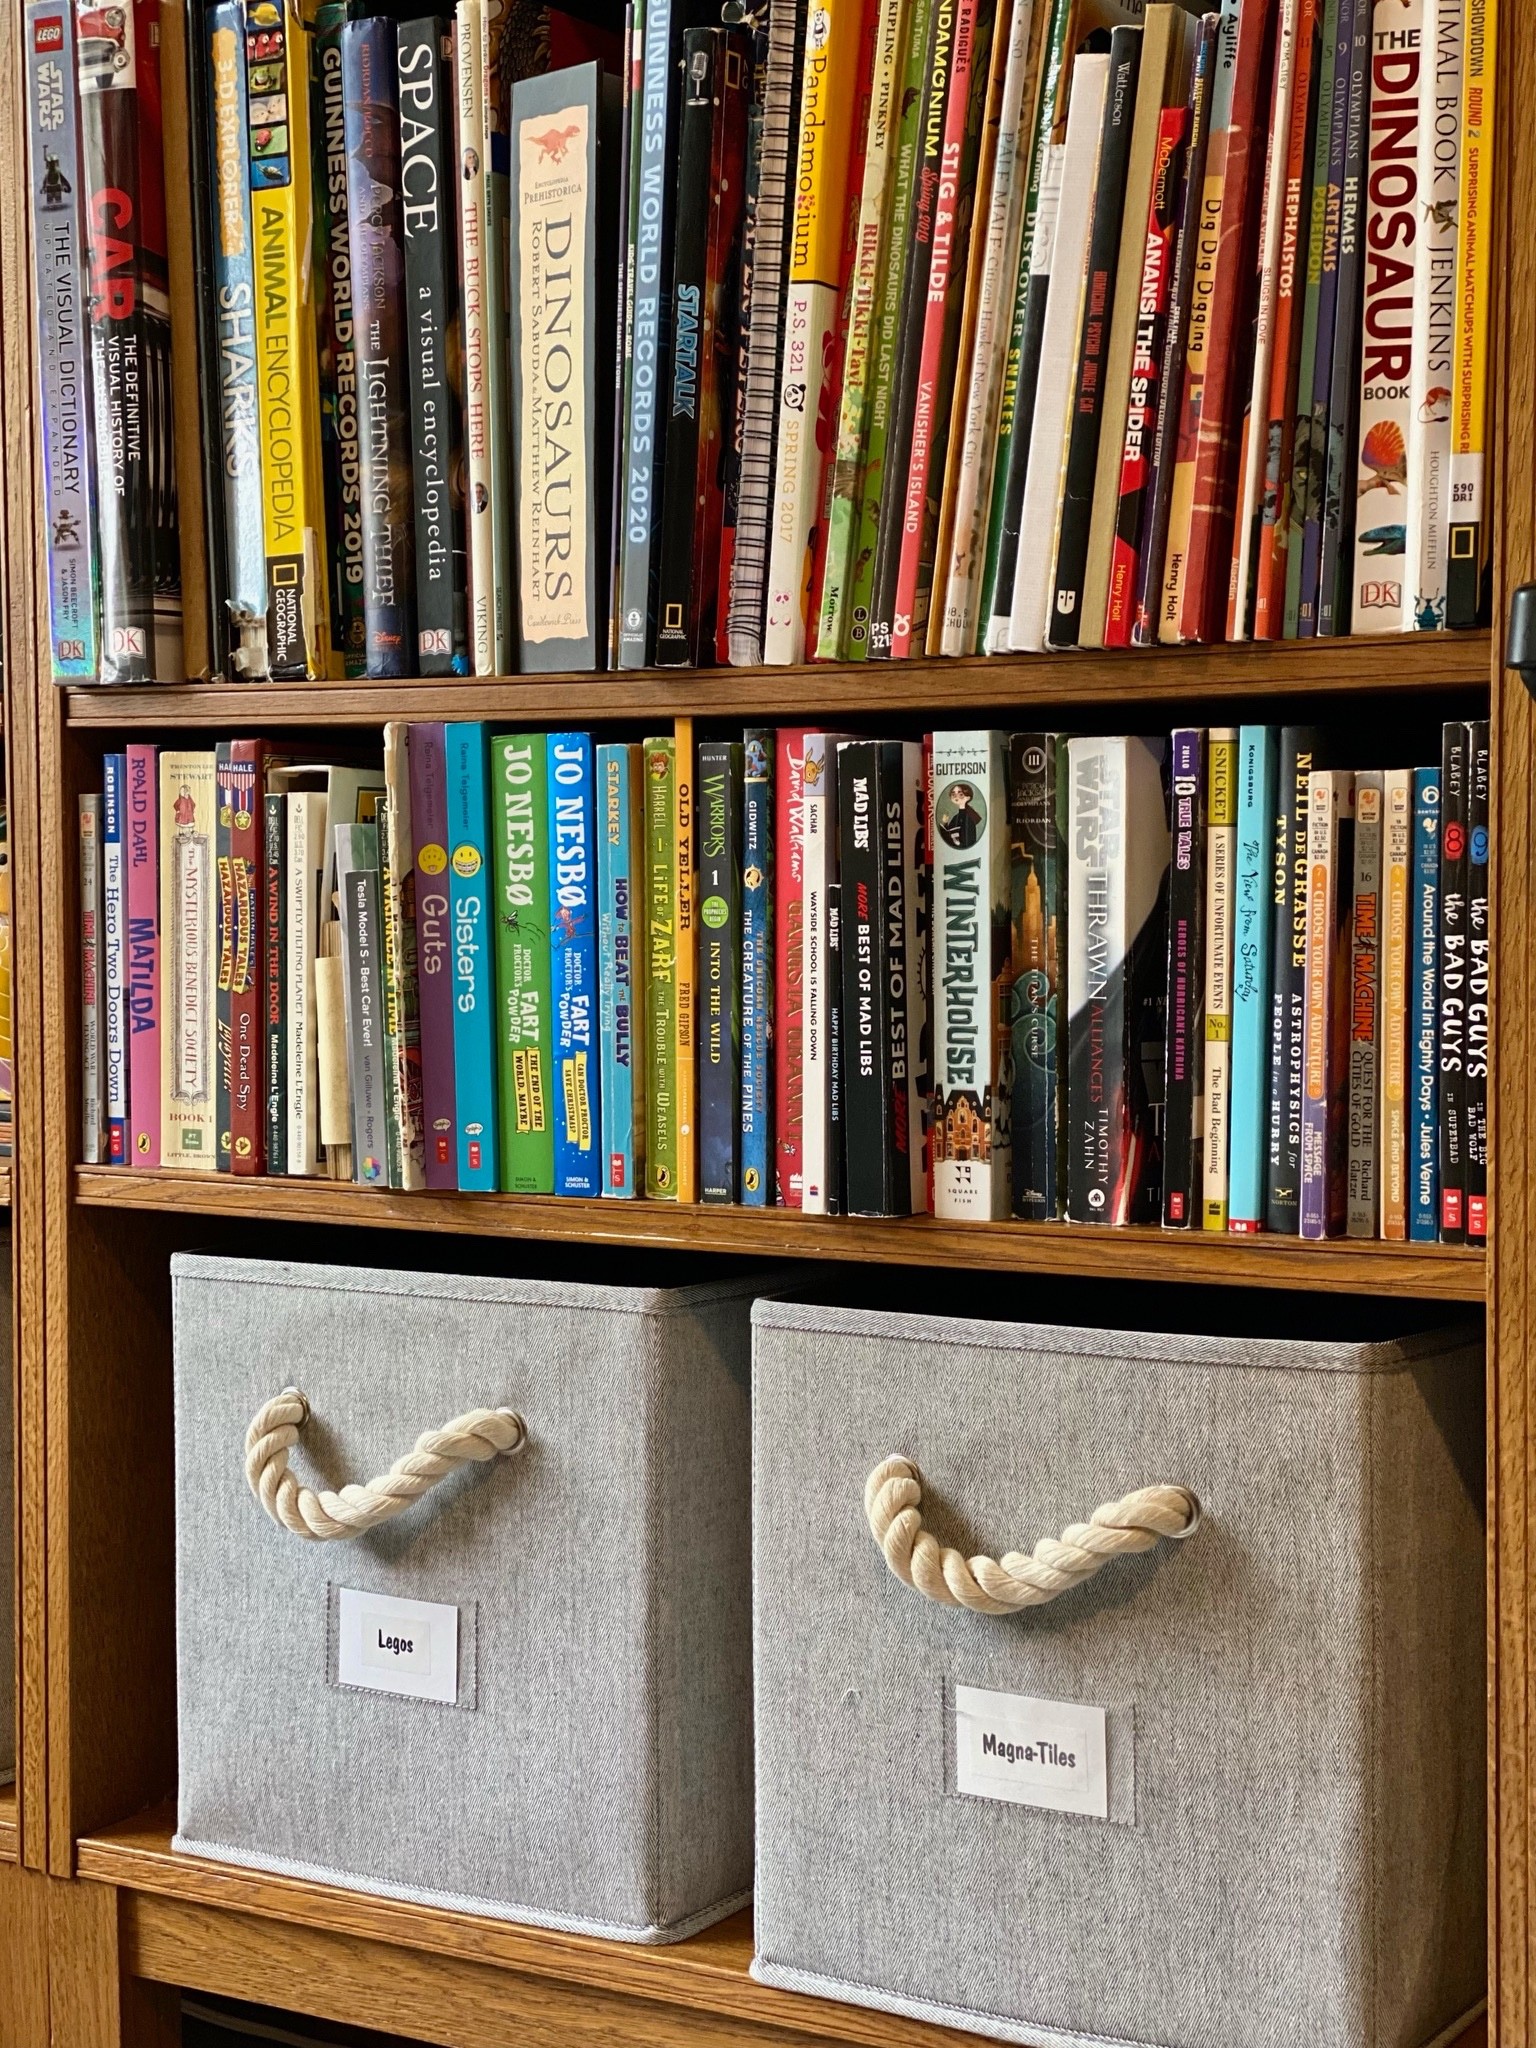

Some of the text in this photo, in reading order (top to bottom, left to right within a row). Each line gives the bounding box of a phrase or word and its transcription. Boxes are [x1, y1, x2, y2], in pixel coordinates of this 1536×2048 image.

[36, 27, 60, 42] LEGO
[461, 23, 473, 118] PROVENSEN
[875, 1, 898, 150] KIPLING PINKNEY
[912, 26, 923, 58] TUMA
[1223, 13, 1238, 69] Ayliffe
[1279, 41, 1291, 90] O'Malley
[1375, 29, 1421, 51] THE
[1113, 62, 1130, 125] Watterson
[398, 44, 438, 238] SPACE
[1155, 137, 1172, 209] McDermott
[1434, 96, 1458, 184] BOOK
[1280, 72, 1307, 297] OLYMPIANS HEPHAISTOS
[1365, 52, 1420, 384] DINOSAUR
[92, 188, 134, 321] CAR
[873, 144, 912, 429] WHAT THE DINOSAURS DID LAST NIGHT
[1089, 272, 1107, 316] HOMICIDAL
[1460, 148, 1479, 436] SURPRISING ANIMAL MATCHUPS WITH SURPRISING
[323, 48, 363, 583] GUINNESS WORLD RECORDS 2019
[1000, 211, 1039, 435] DISCOVER SNAKES
[1084, 322, 1100, 355] PSYCHO
[1258, 267, 1271, 344] SLUGS IN LOVE
[44, 224, 61, 495] UPDATED AND EXPANDED
[218, 282, 255, 478] SHARKS
[262, 207, 294, 541] ANIMAL ENCYCLOPEDIA
[673, 284, 700, 419] STARTALK
[964, 257, 998, 468] Citizen Hawk of New York City
[1081, 360, 1098, 392] JUNGLE
[1364, 388, 1410, 400] BOOK
[108, 335, 124, 496] VISUAL HISTORY OF
[124, 335, 140, 461] THE DEFINITIVE
[419, 288, 445, 580] a visual encyclopedia
[544, 213, 572, 600] DINOSAURS
[1080, 397, 1093, 413] CAT
[363, 320, 394, 605] THE LIGHTNING THIEF
[779, 421, 799, 542] SPRING 2017
[906, 381, 933, 533] VANISHER'S ISLAND
[1453, 484, 1474, 492] 590
[1427, 451, 1440, 570] HOUGHTON MIFFLIN
[70, 559, 79, 628] SIMON BEECROFT
[276, 589, 287, 660] GEOGRAPHIC
[286, 589, 297, 645] NATIONAL
[476, 596, 487, 653] VIKING
[826, 587, 839, 633] Morrow
[872, 623, 889, 634] PS
[1112, 565, 1127, 620] Henry Holt
[1166, 554, 1182, 620] Henry Holt
[424, 742, 434, 829] Raina Telgemeier
[1182, 745, 1190, 769] ZULLO
[1215, 747, 1226, 821] SNICKET
[1449, 746, 1461, 797] BLABEY
[132, 758, 147, 867] ROALD DAHL
[702, 774, 725, 858] WARRIORS
[853, 777, 869, 849] MAD LIBS
[1099, 755, 1121, 867] STAR
[1175, 774, 1196, 870] 10 TRUE TALES
[84, 911, 96, 1005] TIME MACHINE
[219, 862, 231, 984] HAZARDOUS TALES
[234, 862, 249, 987] HAZARDOUS TALES
[422, 895, 448, 975] Guts
[456, 896, 481, 1012] Sisters
[1235, 840, 1259, 1002] The View from Saturday
[1354, 893, 1376, 937] TIME
[106, 856, 121, 1103] The Hero Two Doors Down
[128, 918, 156, 1033] MATILDA
[523, 949, 531, 982] DOCTOR
[857, 882, 872, 1076] MORE BEST OF MAD LIBS
[942, 858, 982, 1084] WINTERHOUSE
[1353, 954, 1376, 1042] MACHINE
[1441, 893, 1465, 1072] the BAD GUYS
[521, 991, 539, 1041] FART
[559, 993, 570, 1047] POWDER
[572, 995, 589, 1045] FART
[679, 983, 690, 1046] FRED GIPSON
[237, 1014, 250, 1111] One Dead Spy
[270, 1034, 279, 1122] Madeleine L'Engle
[530, 1054, 542, 1128] THE END OF THE
[1361, 1052, 1373, 1147] QUEST FOR THE
[1098, 1108, 1109, 1184] TIMOTHY
[378, 1628, 414, 1656] Legos
[983, 1733, 1076, 1768] Magna-Tiles
